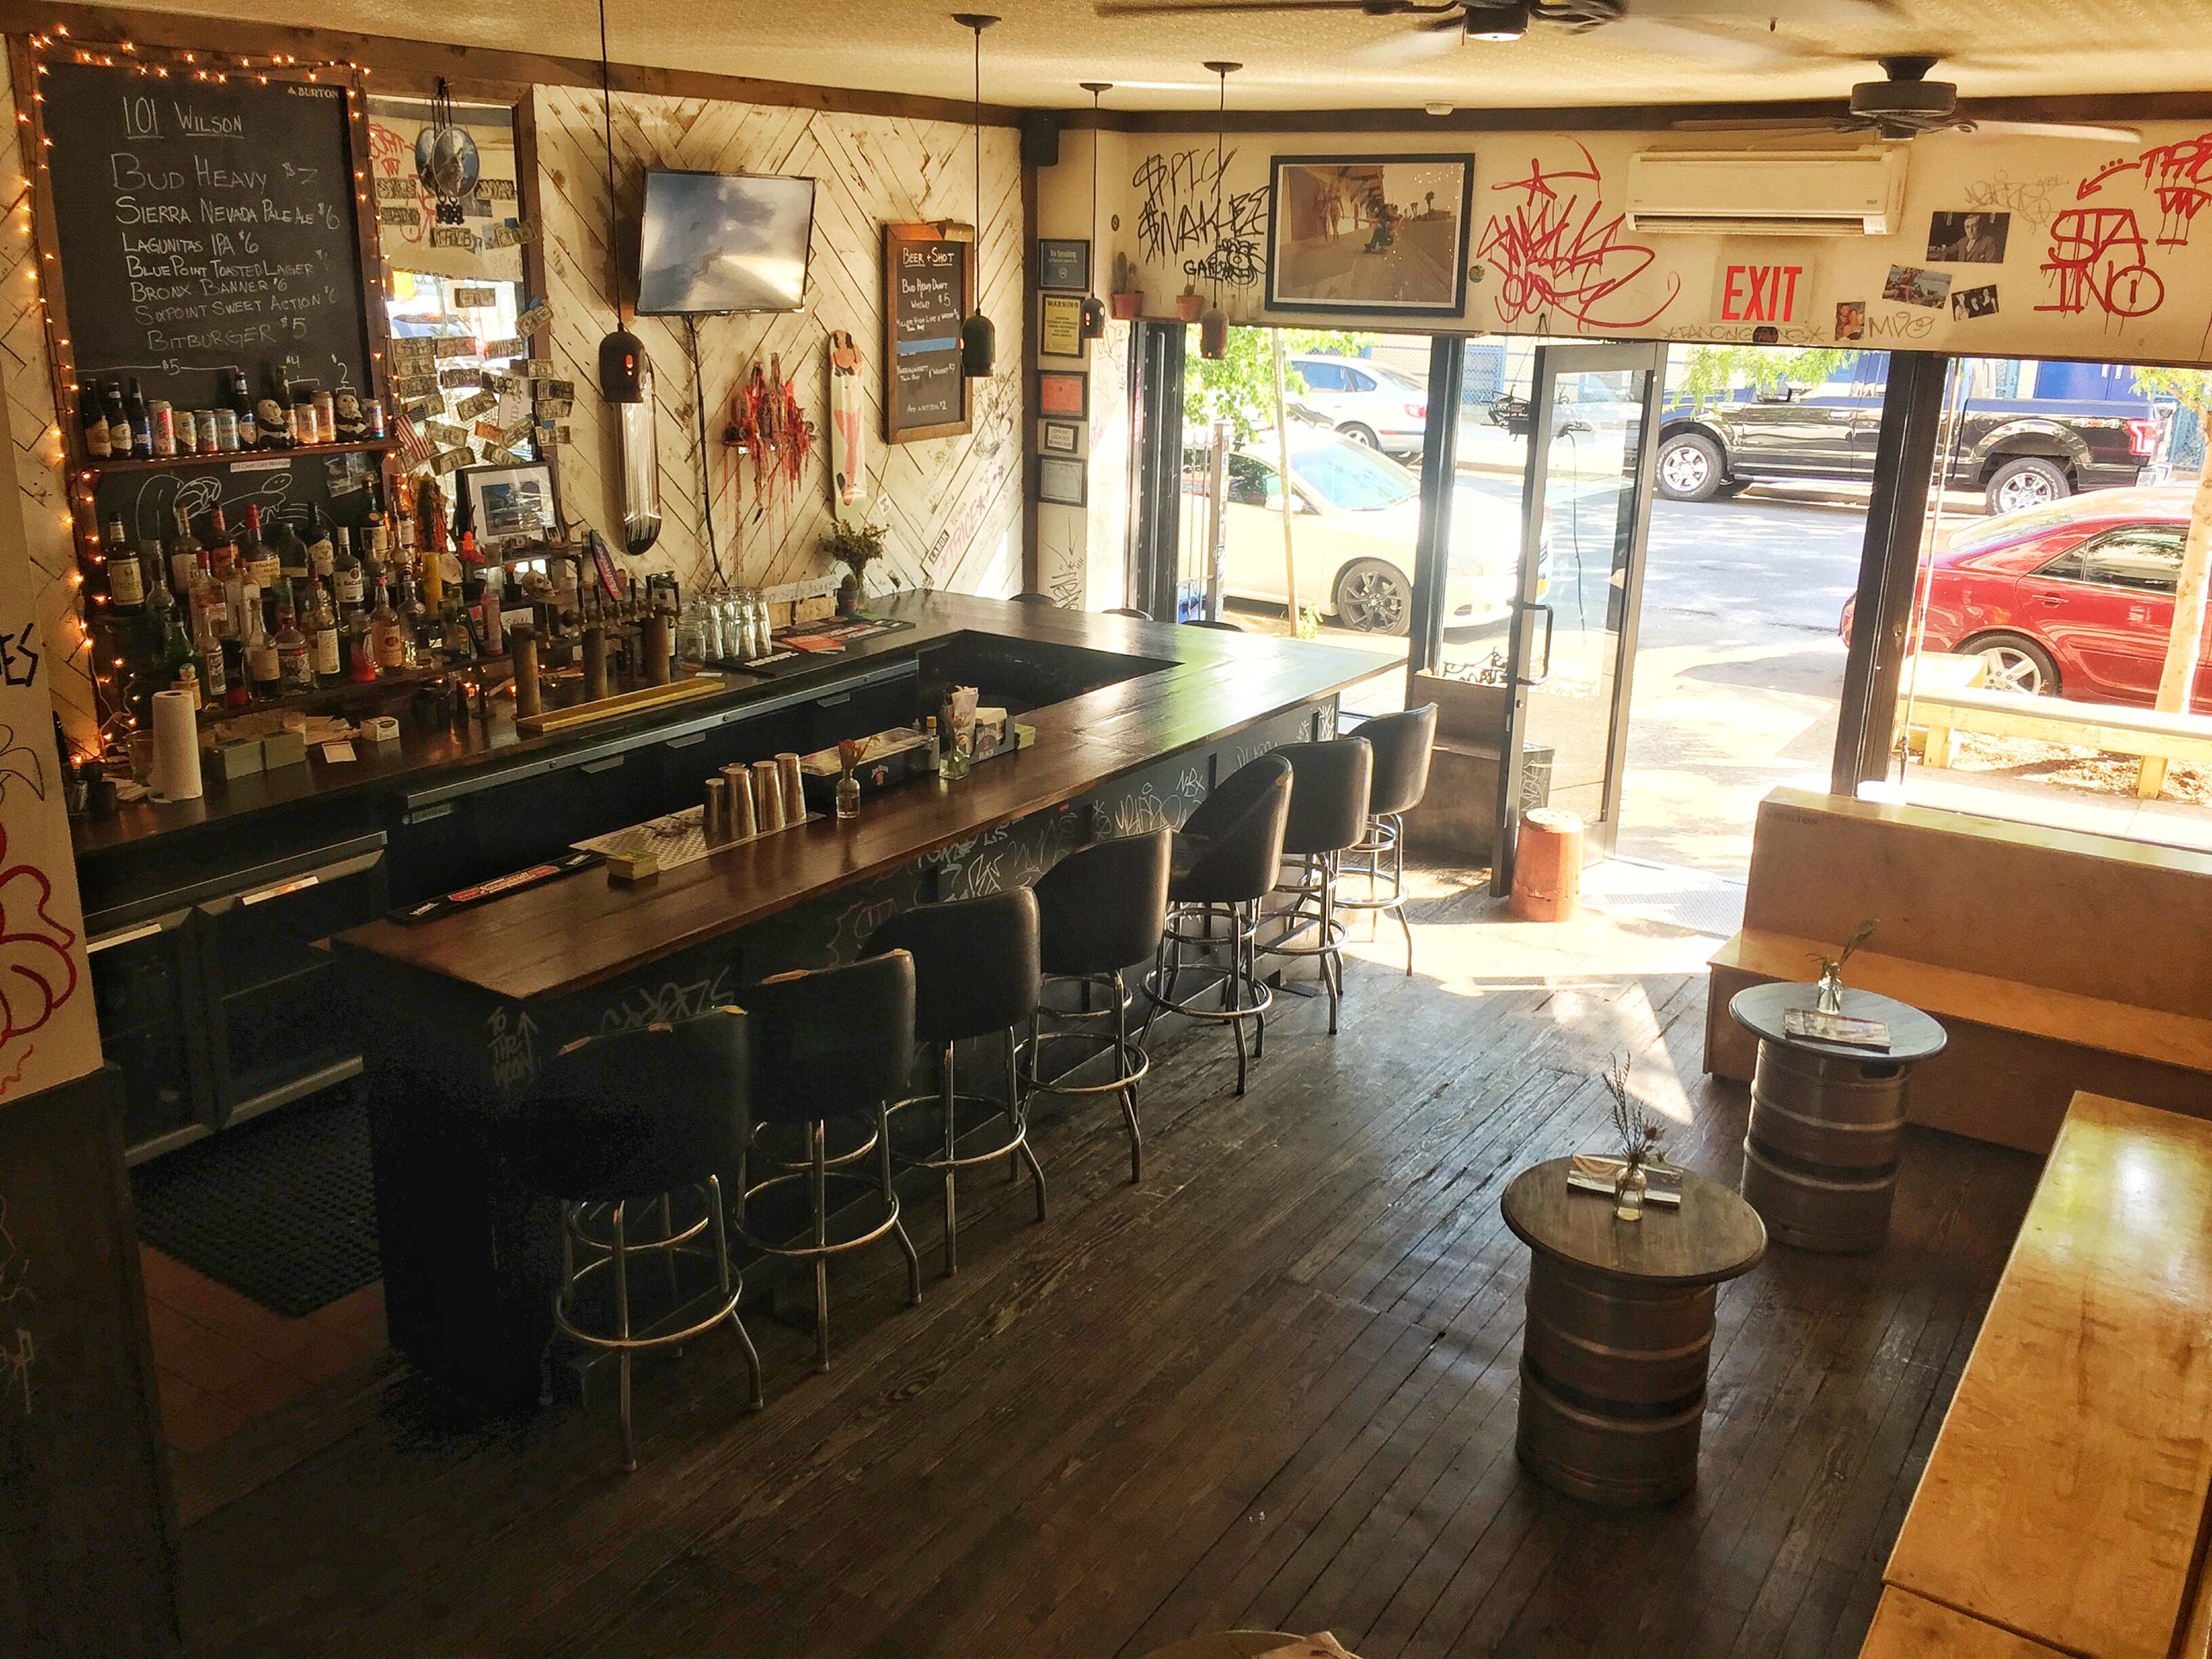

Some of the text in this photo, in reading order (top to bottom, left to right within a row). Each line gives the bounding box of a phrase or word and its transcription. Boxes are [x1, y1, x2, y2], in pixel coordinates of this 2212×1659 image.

[298, 88, 339, 99] BURTON
[123, 97, 242, 134] 101 WILSON
[111, 153, 184, 190] BUD
[194, 155, 266, 195] HEAVY
[116, 196, 340, 229] SIERRA NEVADA PALE ALE $6
[122, 230, 258, 256] LAGUNITAS IPA $6
[903, 247, 925, 264] BEER
[931, 247, 955, 263] SHOT
[126, 255, 171, 278] BLUE
[169, 255, 207, 276] POINT
[210, 259, 263, 279] TOASTED
[263, 260, 314, 276] LAGER
[130, 277, 287, 302] BRONX BANNER $6
[902, 278, 916, 293] BUD
[1722, 266, 1802, 321] EXIT
[135, 305, 208, 325] SIXPOINT
[212, 300, 262, 316] SWEET
[271, 294, 321, 311] ACTION
[937, 292, 951, 307] $5
[1047, 300, 1079, 309] WARNING
[147, 315, 307, 351] BITBURGER $5
[162, 358, 180, 376] $5
[287, 355, 300, 369] $4
[930, 533, 948, 562] LABOR
